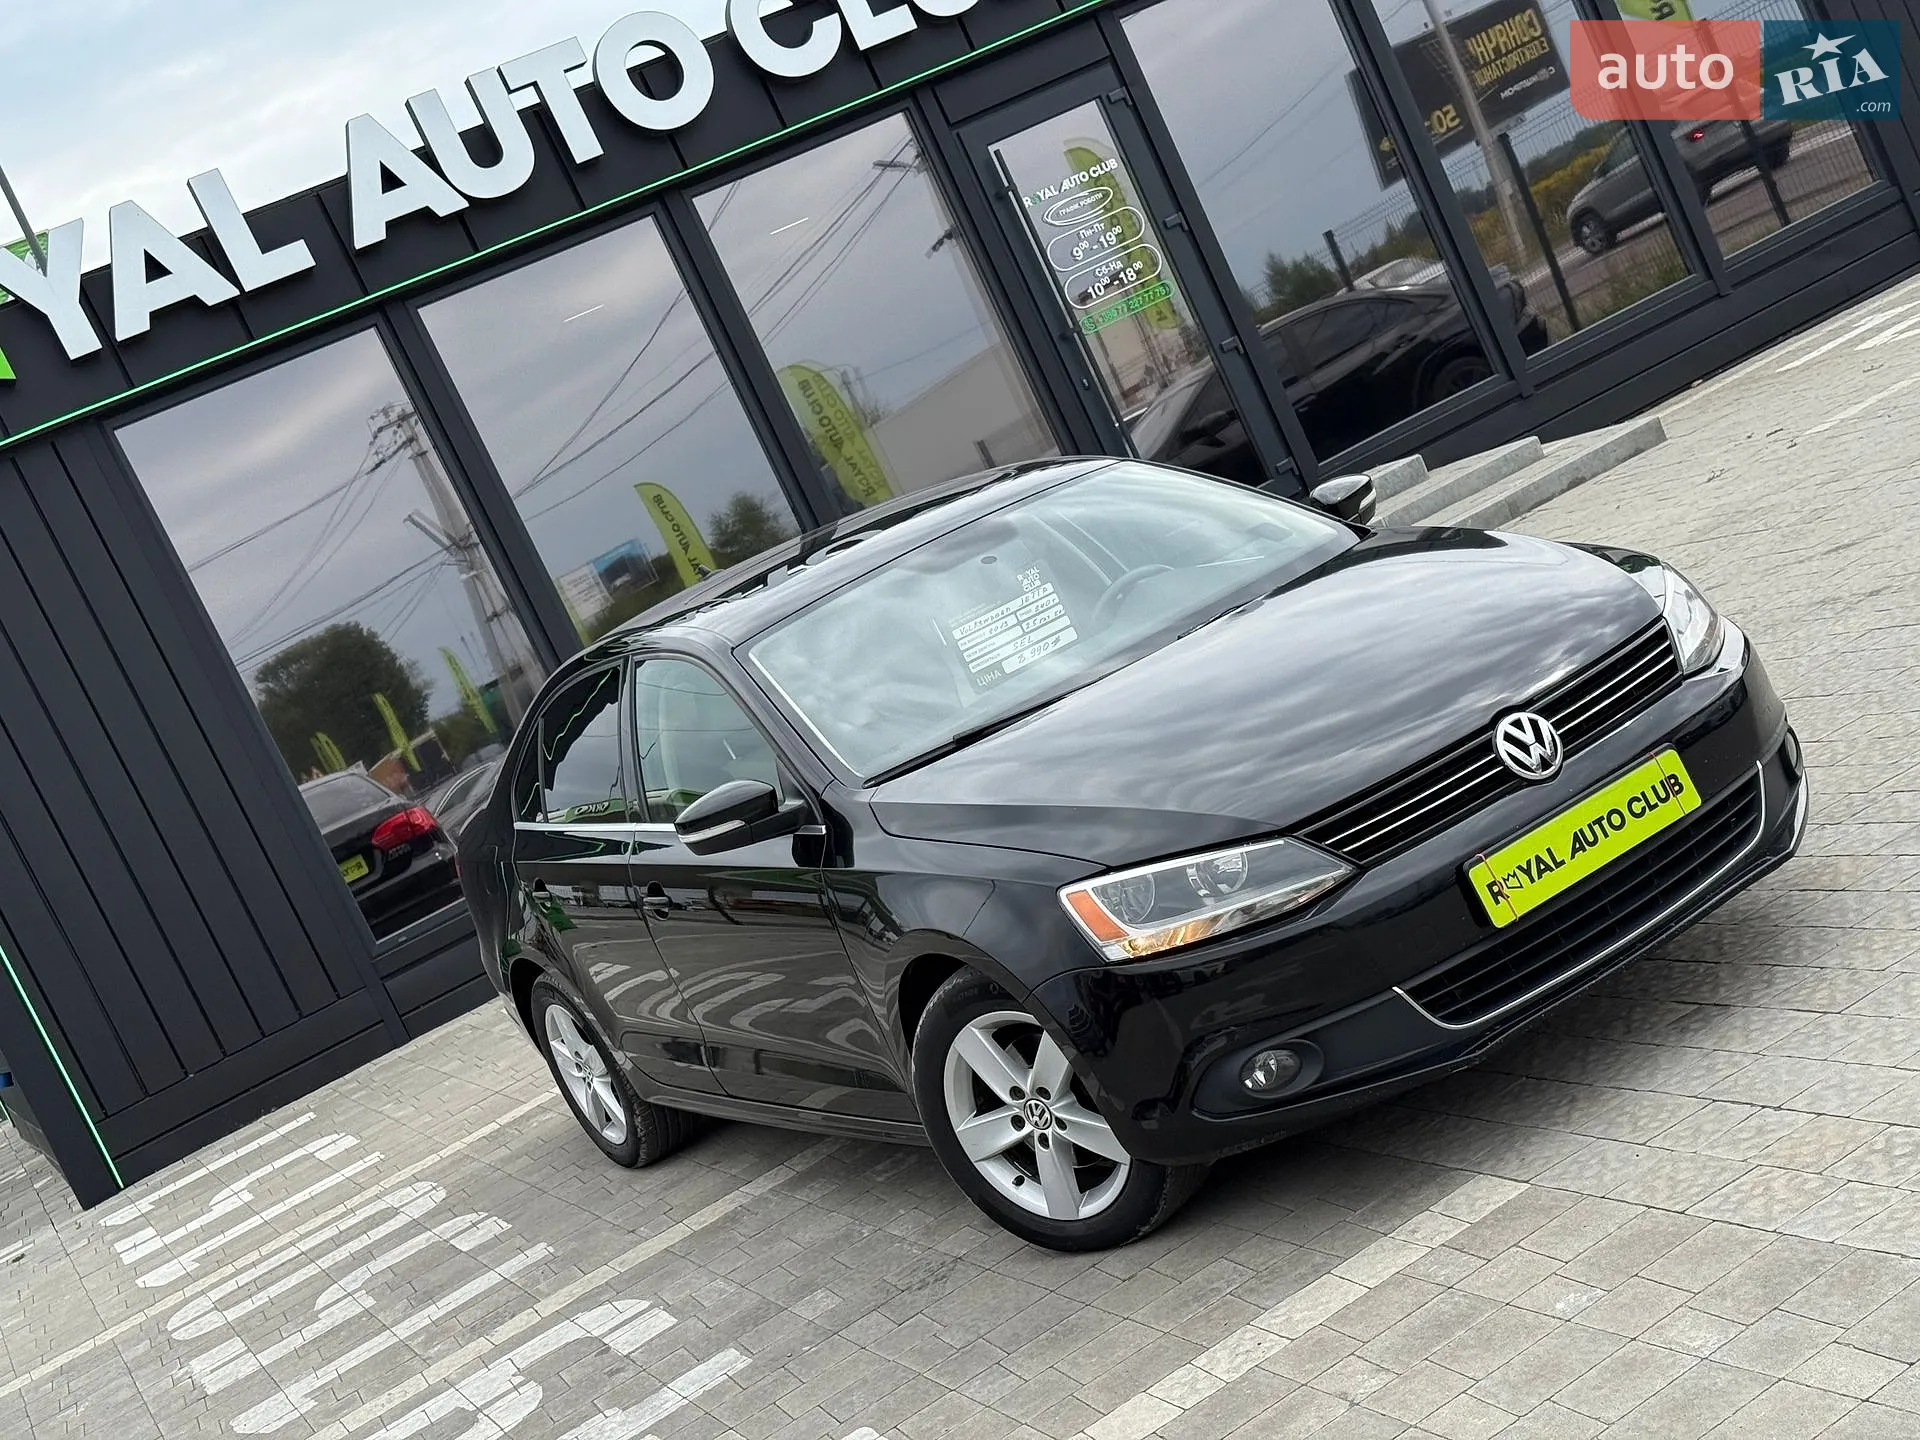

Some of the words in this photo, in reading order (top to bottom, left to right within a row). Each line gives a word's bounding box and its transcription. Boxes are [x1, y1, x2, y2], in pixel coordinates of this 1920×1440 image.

[345, 11, 714, 250] AUTO
[1061, 171, 1089, 193] AUTO
[1089, 158, 1118, 178] CLUB
[1079, 222, 1105, 239] Пн-Пт
[1095, 260, 1124, 277] Сб-Нд
[1022, 573, 1040, 587] AUTO
[1023, 580, 1041, 592] CLUB
[1013, 635, 1034, 650] SEL
[976, 670, 1001, 687] ЦІНА
[1570, 808, 1626, 861] AUTO
[1628, 773, 1684, 825] CLUB
